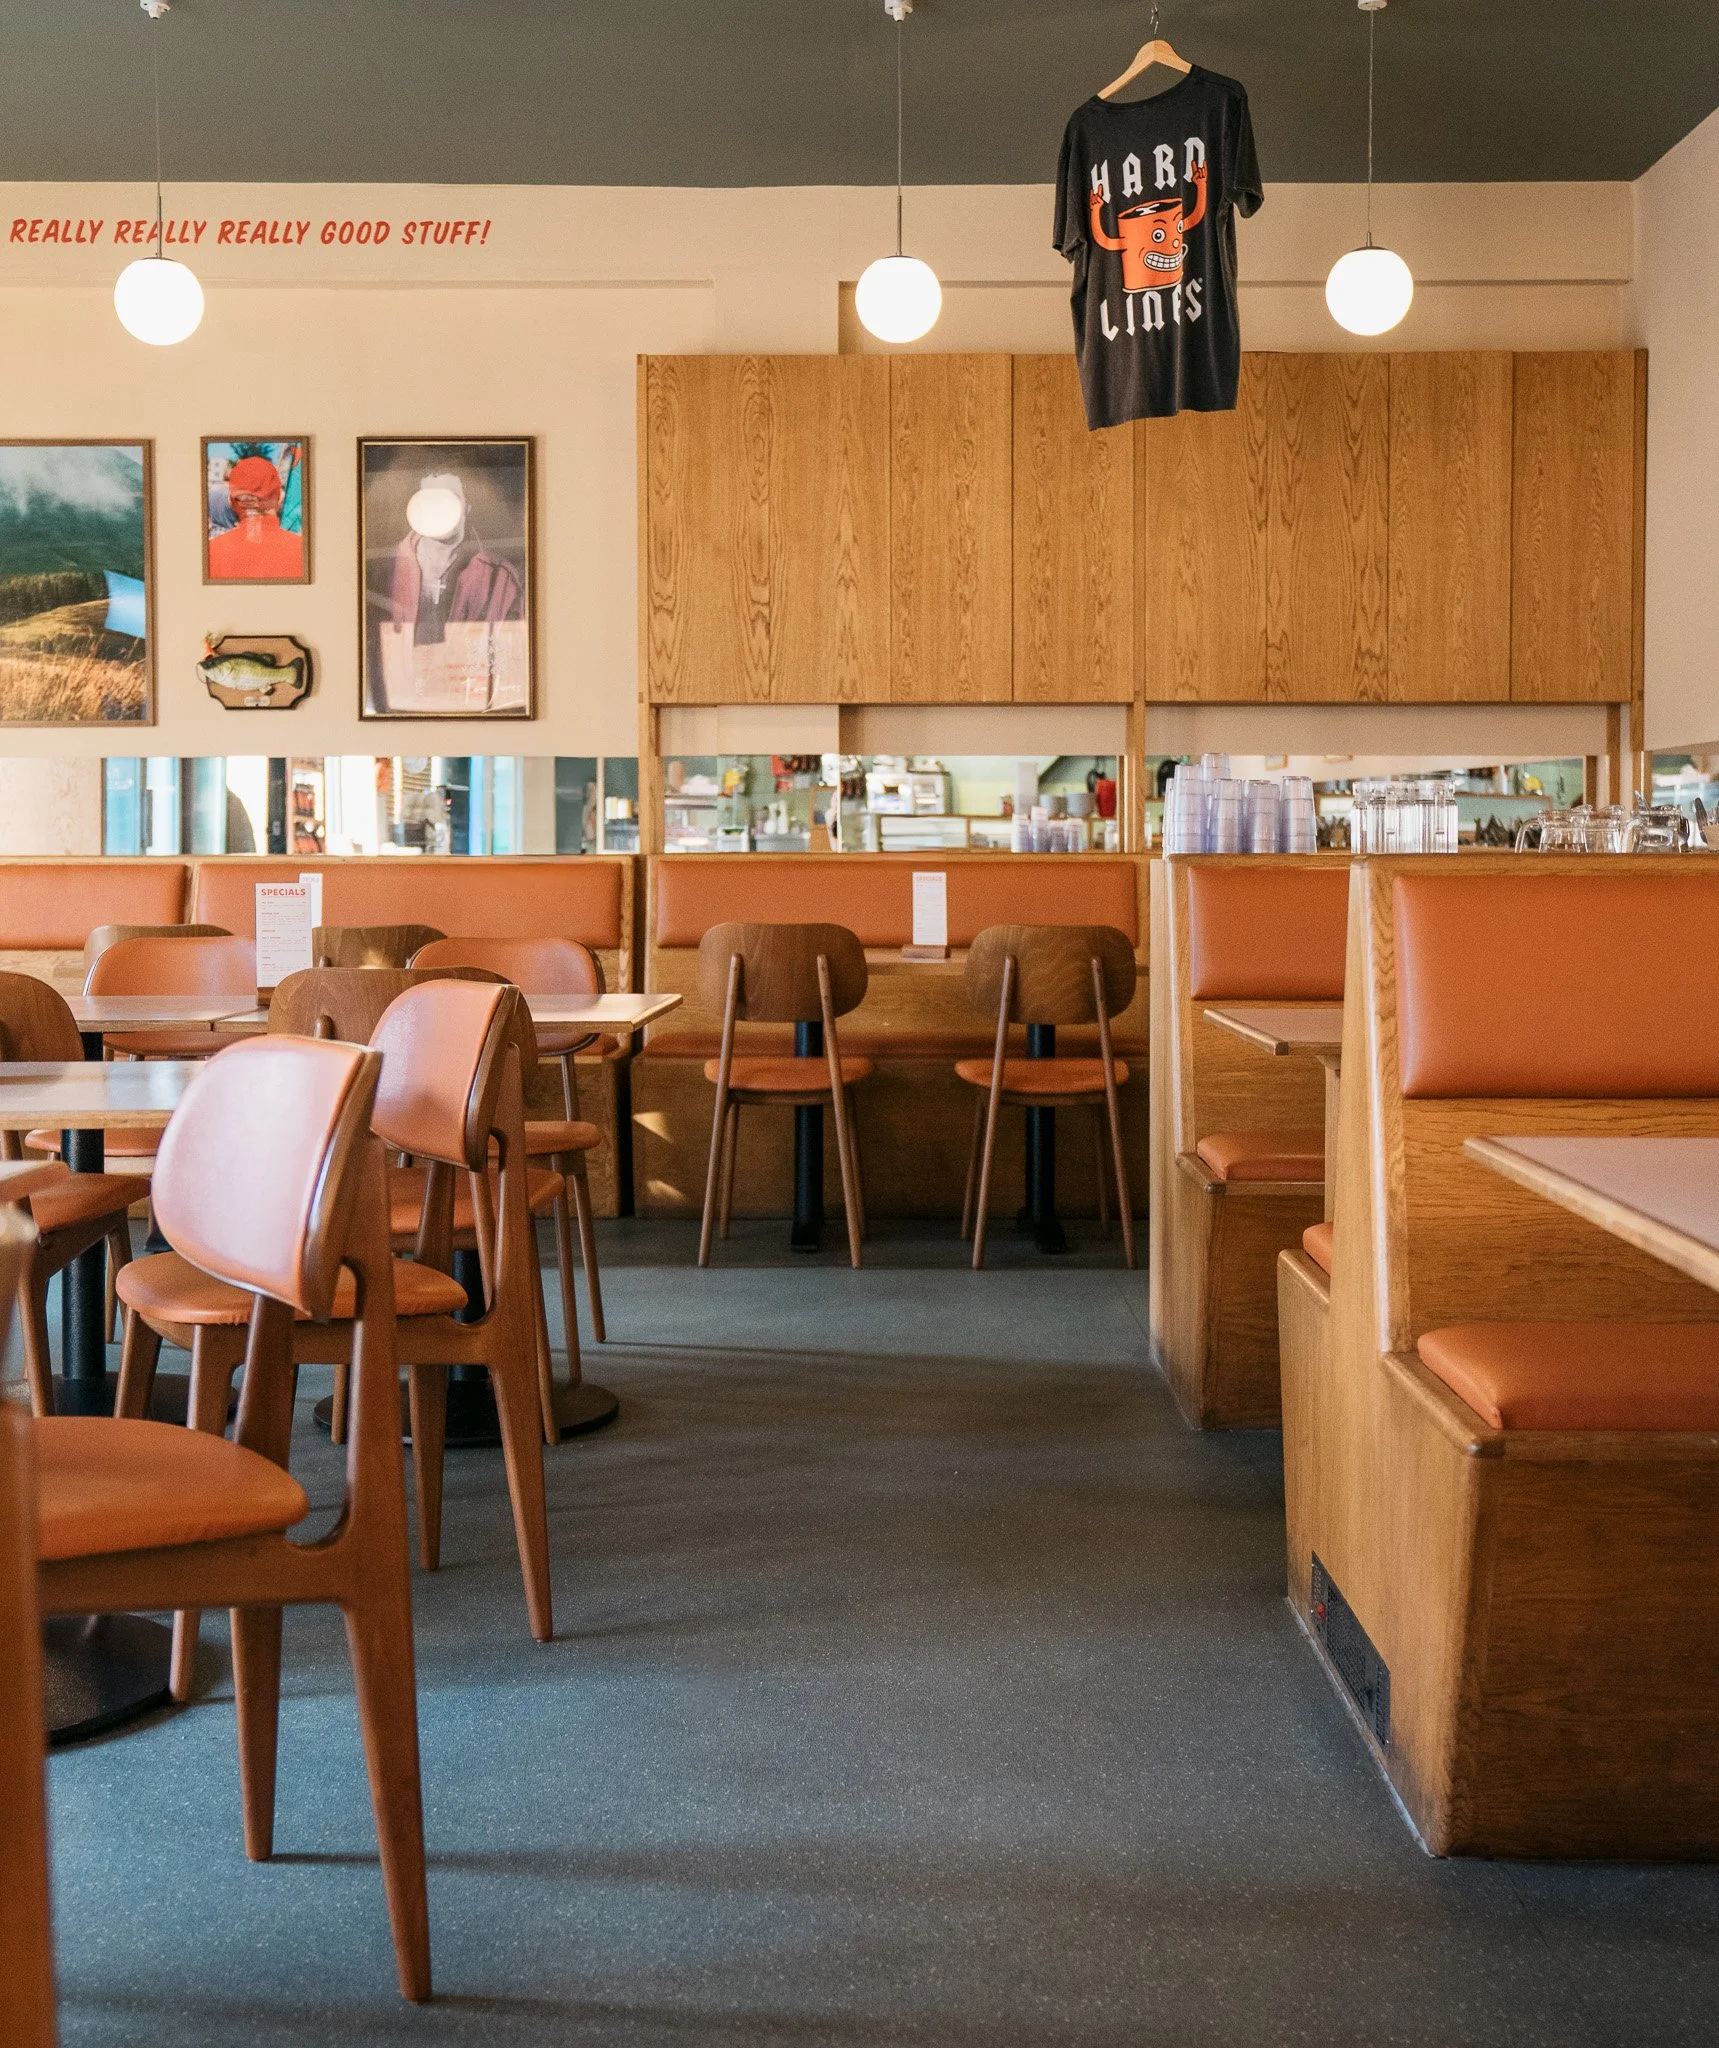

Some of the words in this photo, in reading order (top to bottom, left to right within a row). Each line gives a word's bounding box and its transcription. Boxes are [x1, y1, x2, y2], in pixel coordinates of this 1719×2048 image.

[9, 218, 104, 244] REALLY
[113, 219, 207, 244] REALLY
[216, 219, 310, 244] REALLY
[320, 220, 390, 245] GOOD
[401, 219, 492, 245] STUFF!
[261, 888, 307, 896] SPECIALS
